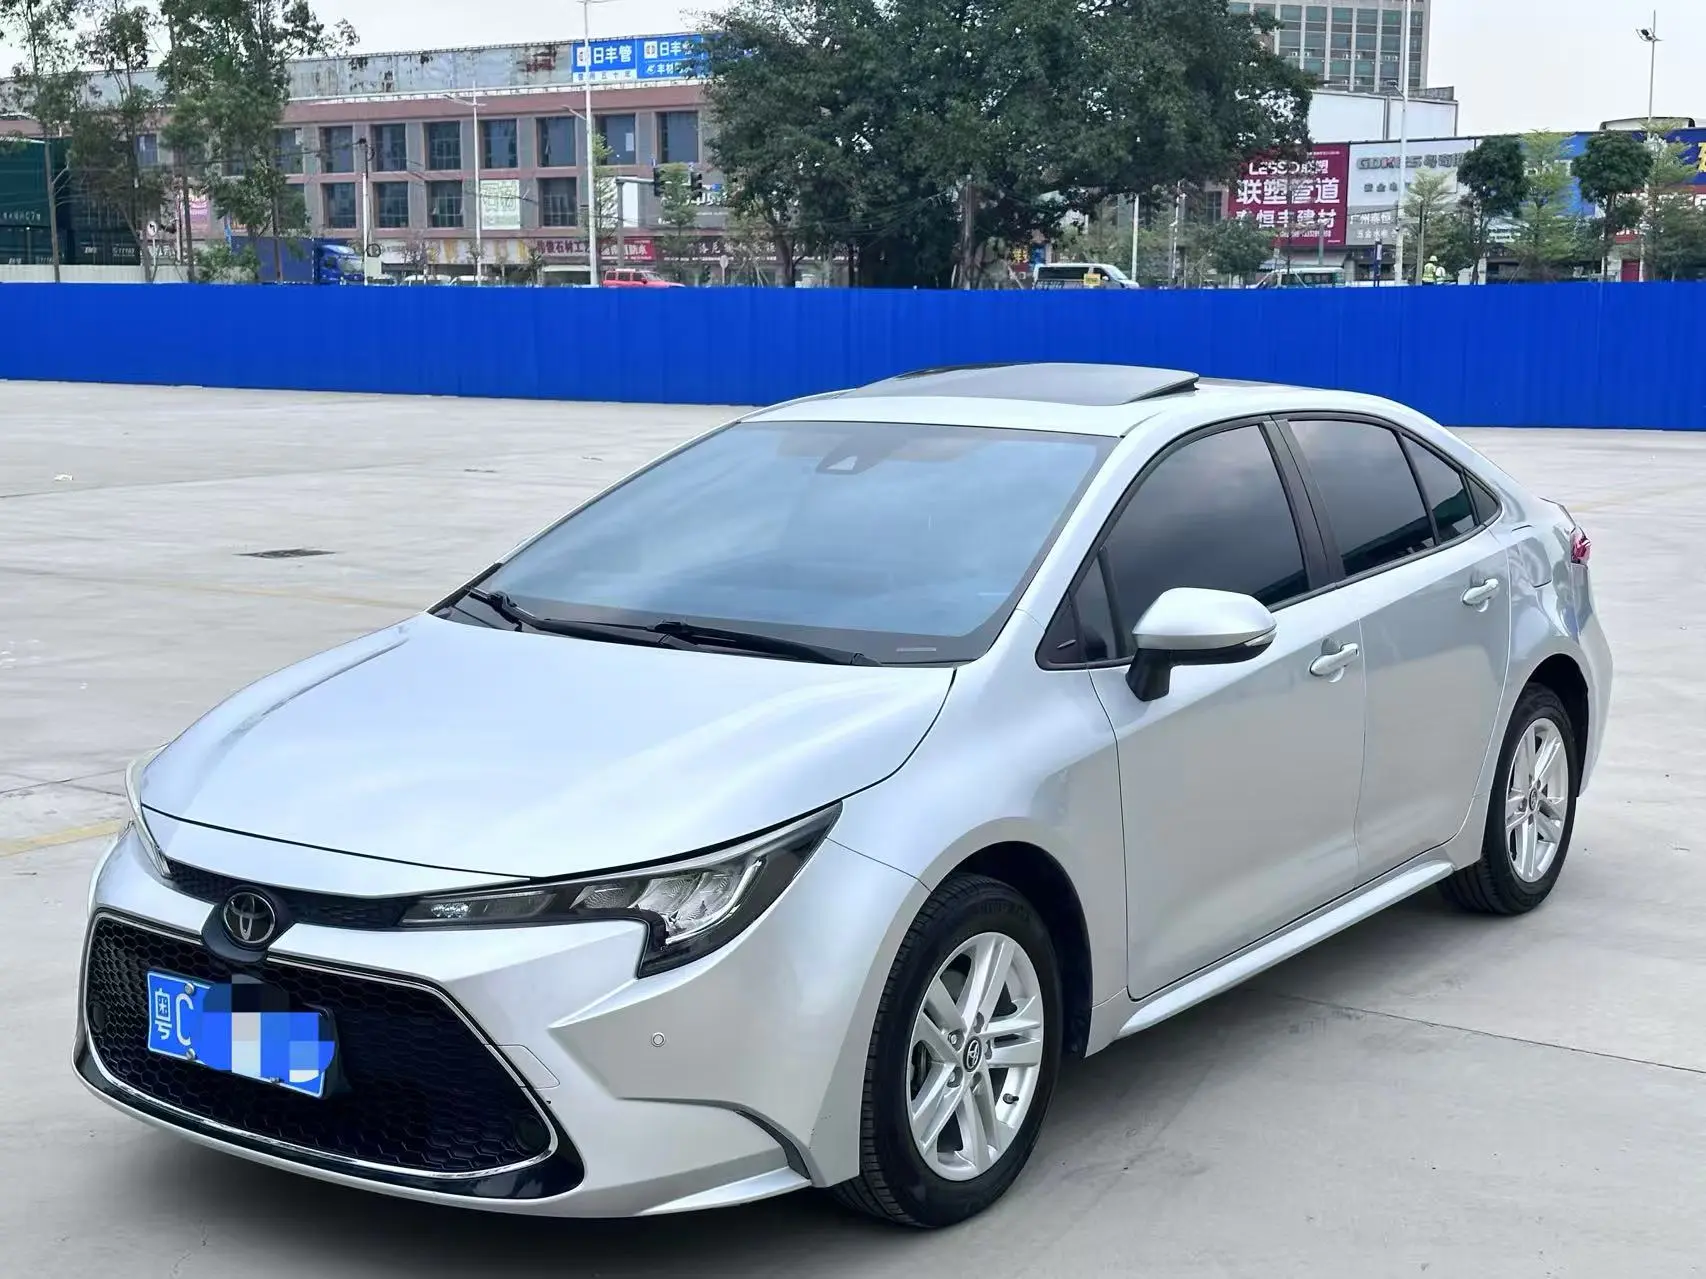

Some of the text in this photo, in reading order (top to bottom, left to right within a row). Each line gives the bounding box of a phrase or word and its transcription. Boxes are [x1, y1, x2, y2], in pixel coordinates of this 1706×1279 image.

[593, 45, 632, 64] 日丰管
[1236, 177, 1340, 204] 联塑管道
